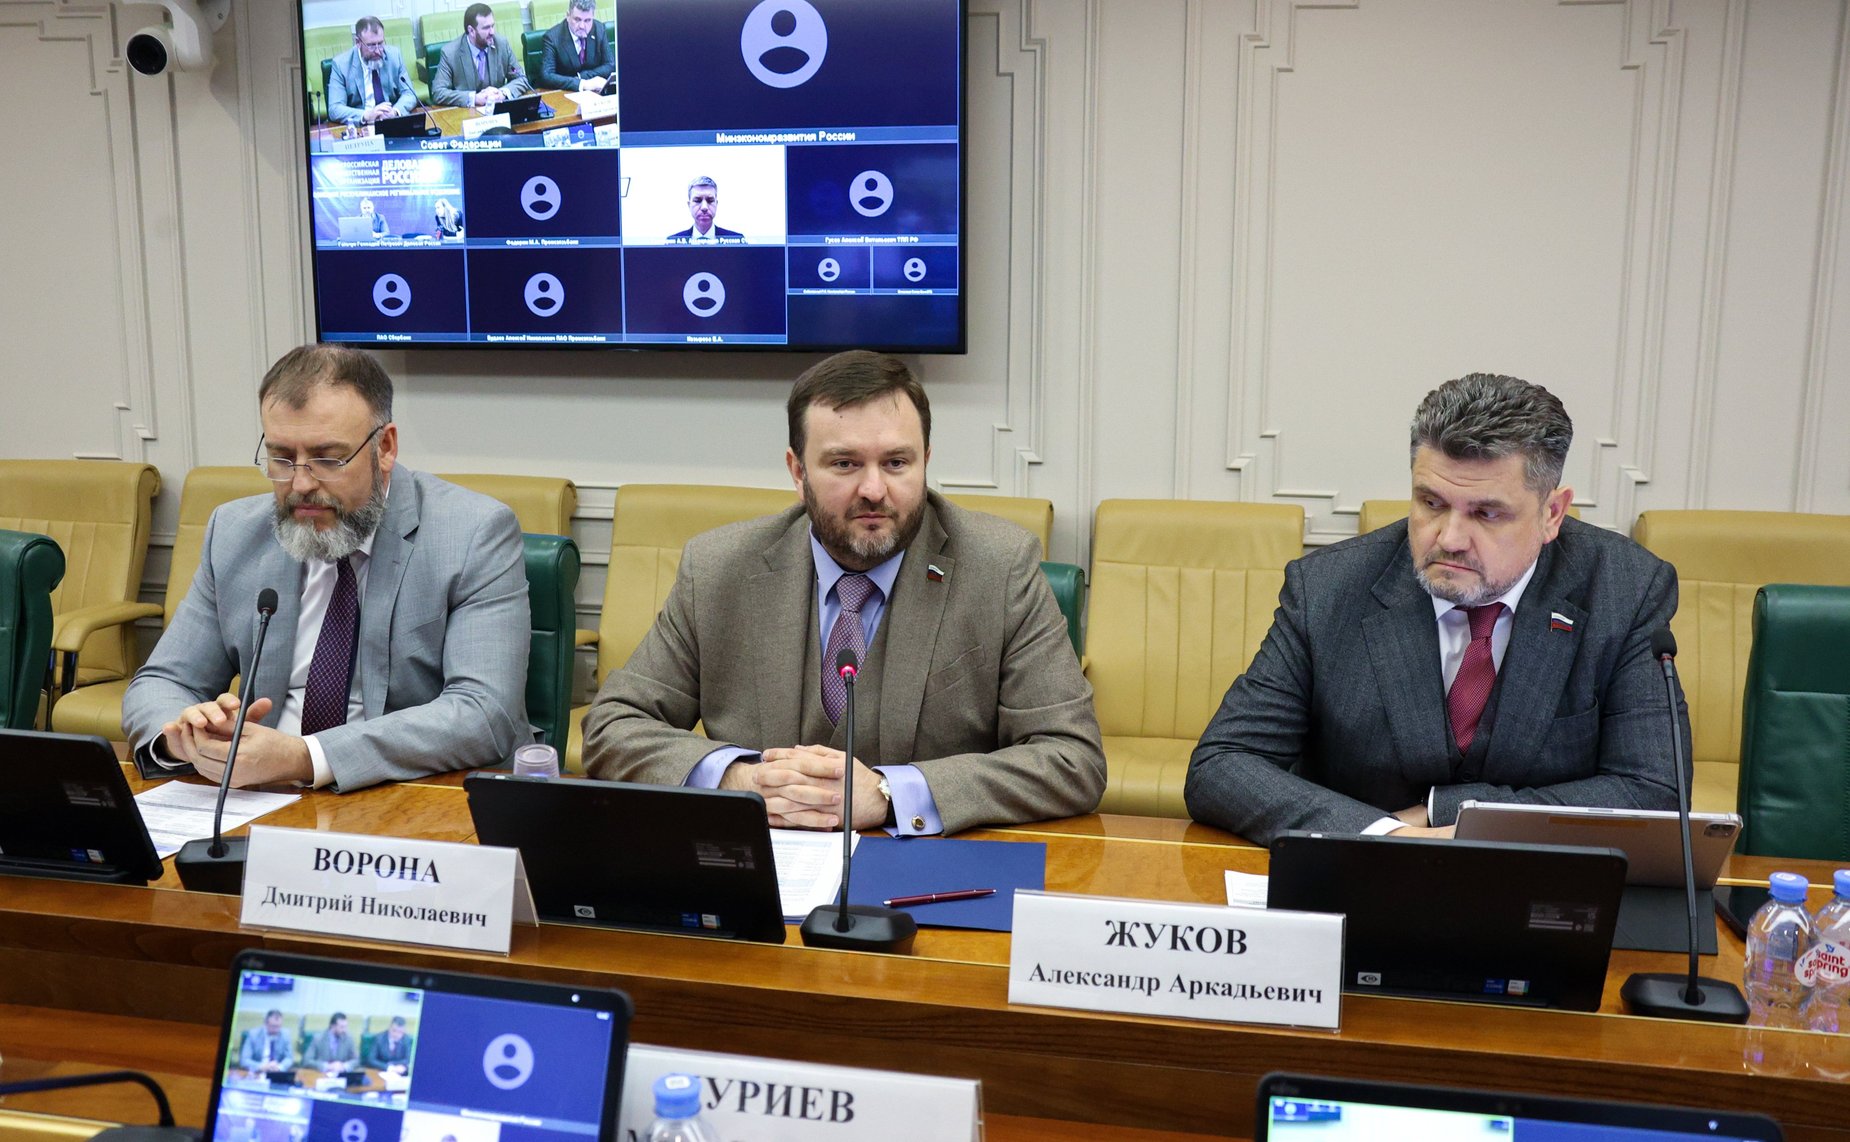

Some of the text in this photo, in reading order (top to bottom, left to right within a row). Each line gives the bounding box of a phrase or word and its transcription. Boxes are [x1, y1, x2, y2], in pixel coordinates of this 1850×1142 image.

[420, 139, 502, 150] Совет Федерации
[716, 131, 856, 144] Минэкономразвития России
[313, 847, 441, 884] ВОРОНА
[261, 885, 487, 927] Дмитрий Николаевич
[1104, 919, 1248, 956] ЖУКОВ
[1029, 962, 1323, 1004] Александр Аркадьевич
[671, 1072, 856, 1124] УРИЕВ
